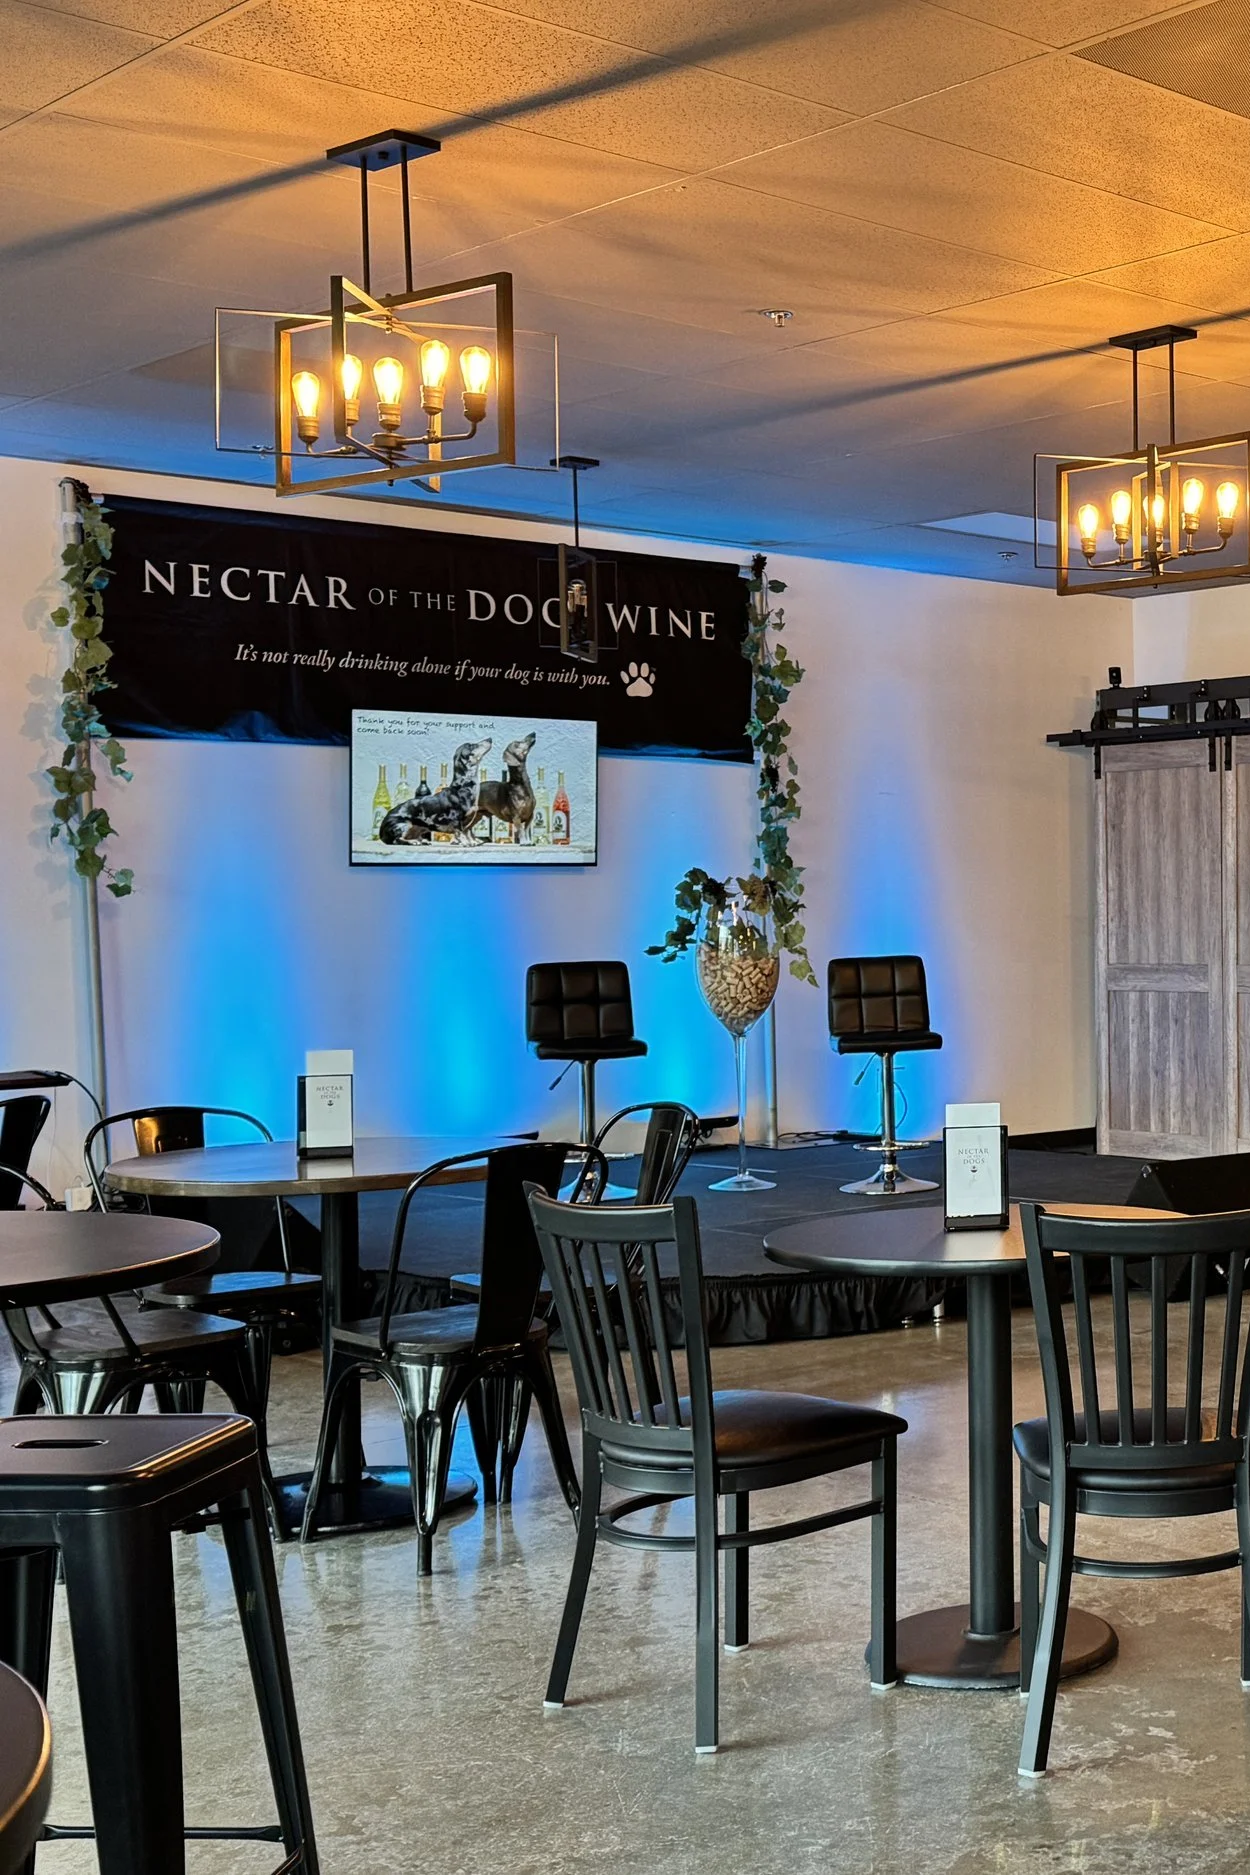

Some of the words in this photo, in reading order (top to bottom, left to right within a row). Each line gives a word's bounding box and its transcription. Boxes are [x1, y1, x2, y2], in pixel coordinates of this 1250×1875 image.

[142, 559, 356, 610] NECTAR
[368, 587, 398, 606] OF
[409, 591, 456, 611] THE
[605, 602, 716, 641] WINE
[262, 651, 289, 664] not
[293, 649, 335, 672] really
[338, 651, 409, 677] drinking
[411, 656, 451, 674] alone
[454, 659, 471, 681] if
[467, 665, 502, 681] your
[504, 663, 531, 685] dog
[533, 667, 544, 681] is
[547, 667, 578, 683] with
[578, 674, 611, 689] you.
[357, 716, 384, 724] Thank
[388, 719, 403, 728] you
[407, 717, 420, 727] for
[424, 721, 442, 730] your
[446, 721, 475, 731] support
[383, 726, 404, 735] back
